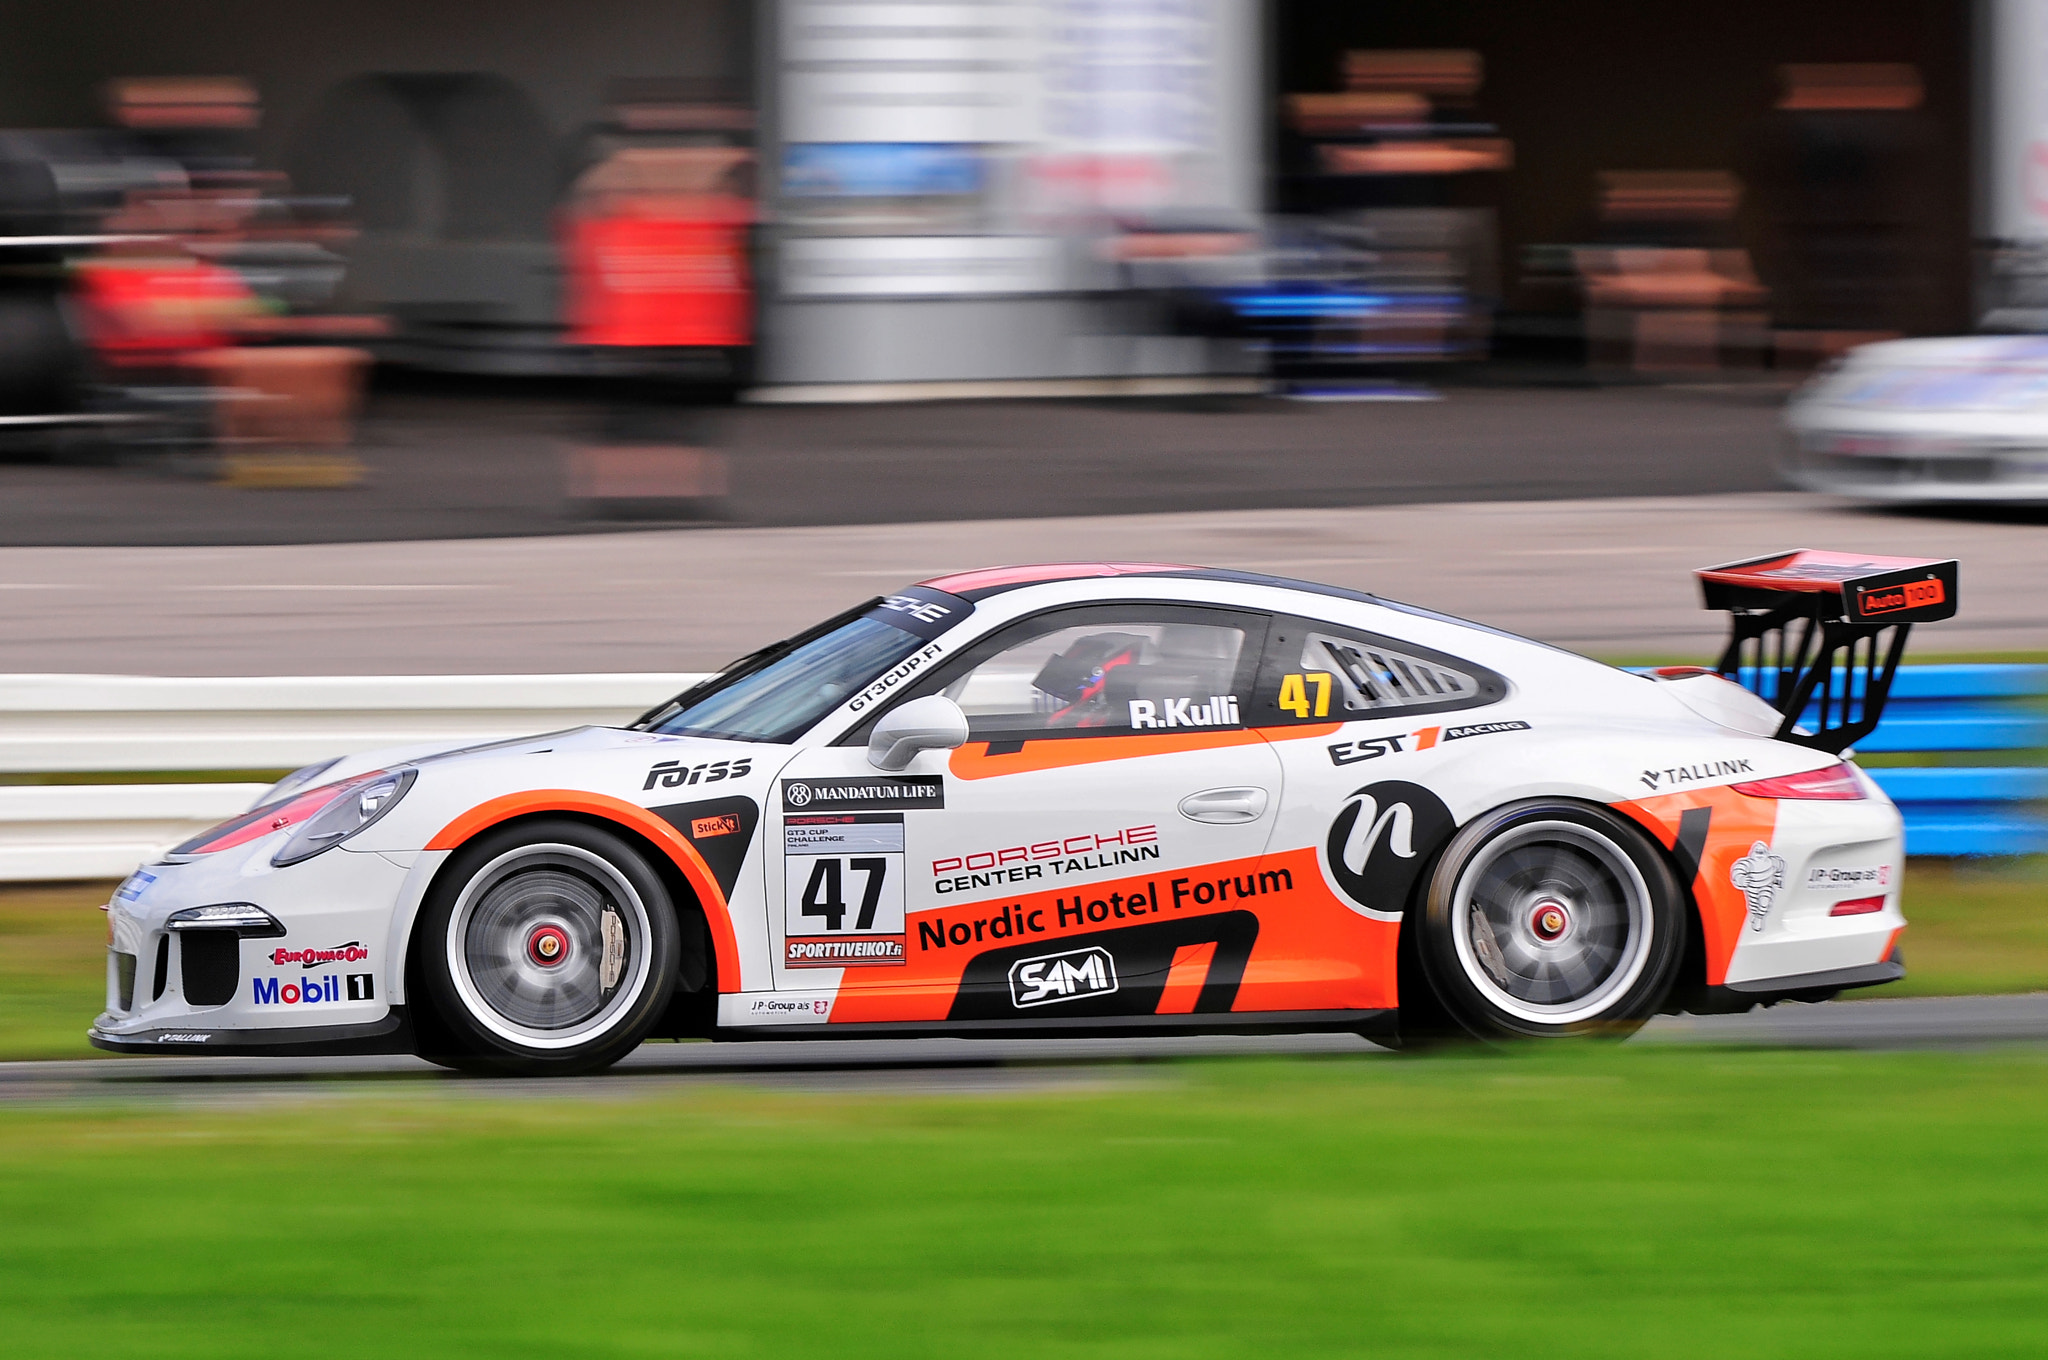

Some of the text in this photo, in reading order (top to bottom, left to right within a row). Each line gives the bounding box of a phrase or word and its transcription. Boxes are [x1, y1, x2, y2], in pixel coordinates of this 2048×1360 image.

[1865, 585, 1938, 610] Auto 100
[848, 643, 943, 713] GT3CUP.FI
[1278, 672, 1332, 718] 47
[1128, 695, 1241, 729] R.Kulli
[1448, 721, 1523, 738] RACING
[1664, 759, 1754, 784] TALLINK
[815, 785, 936, 800] MANDATUM LIFE
[697, 821, 723, 833] Stick
[787, 816, 855, 824] PORSCHE
[932, 825, 1158, 877] PORSCHE
[935, 845, 1160, 894] CENTER TALLINN
[801, 858, 886, 930] 47
[918, 867, 1293, 951] Nordic Hotel Forum
[788, 942, 903, 958] SPORTTIVEIKOT.fi
[253, 975, 364, 1004] Mobil 1
[1019, 953, 1109, 1001] SAMI
